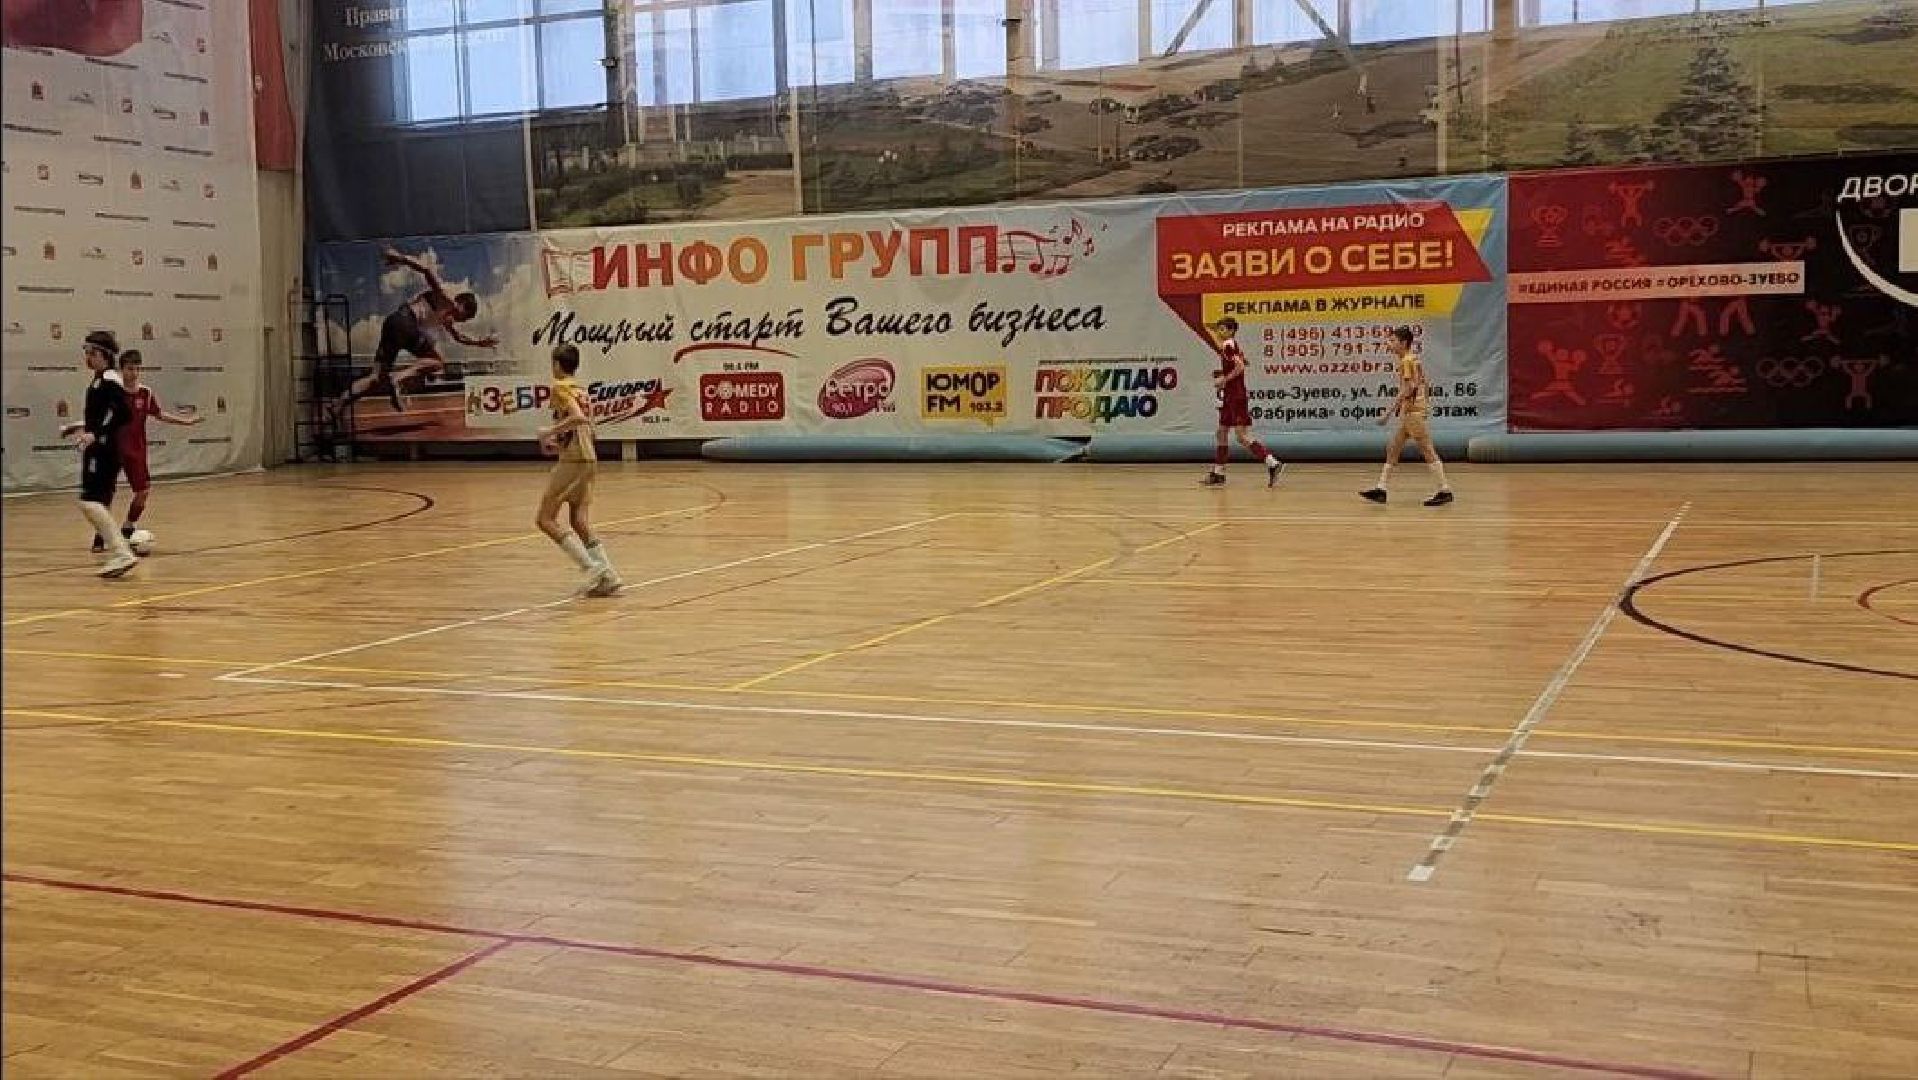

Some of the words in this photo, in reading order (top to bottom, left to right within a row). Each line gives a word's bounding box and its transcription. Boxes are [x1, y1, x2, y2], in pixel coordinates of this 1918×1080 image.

[1222, 219, 1318, 238] РЕКЛАМА
[1321, 216, 1350, 232] НА
[1354, 212, 1425, 231] РАДИО
[592, 236, 770, 290] ИНФО
[790, 226, 999, 281] ГРУПП
[1170, 246, 1296, 280] ЗАЯВИ
[1304, 246, 1333, 275] О
[1339, 239, 1454, 273] СЕБЕ!
[1591, 277, 1651, 291] РОССИЯ
[1222, 300, 1310, 316] РЕКЛАМА
[1315, 299, 1328, 312] В
[1331, 293, 1425, 311] ЖУРНАЛЕ
[531, 310, 675, 355] Мощный
[689, 308, 805, 348] старт
[825, 296, 952, 336] Вашего
[968, 300, 1107, 348] бизнеса
[1263, 327, 1274, 342] 8
[1280, 326, 1325, 343] (496)
[1263, 344, 1274, 357] 8
[1280, 343, 1325, 360] (905)
[1263, 359, 1400, 375] www.ozzebra.
[704, 382, 779, 400] COMEDY
[925, 371, 1001, 397] ЮМОР
[1035, 366, 1178, 393] ПОКУПАЮ
[704, 401, 779, 414] RADIO
[1034, 394, 1159, 424] ПРОДАЮ
[1431, 405, 1479, 418] этаж
